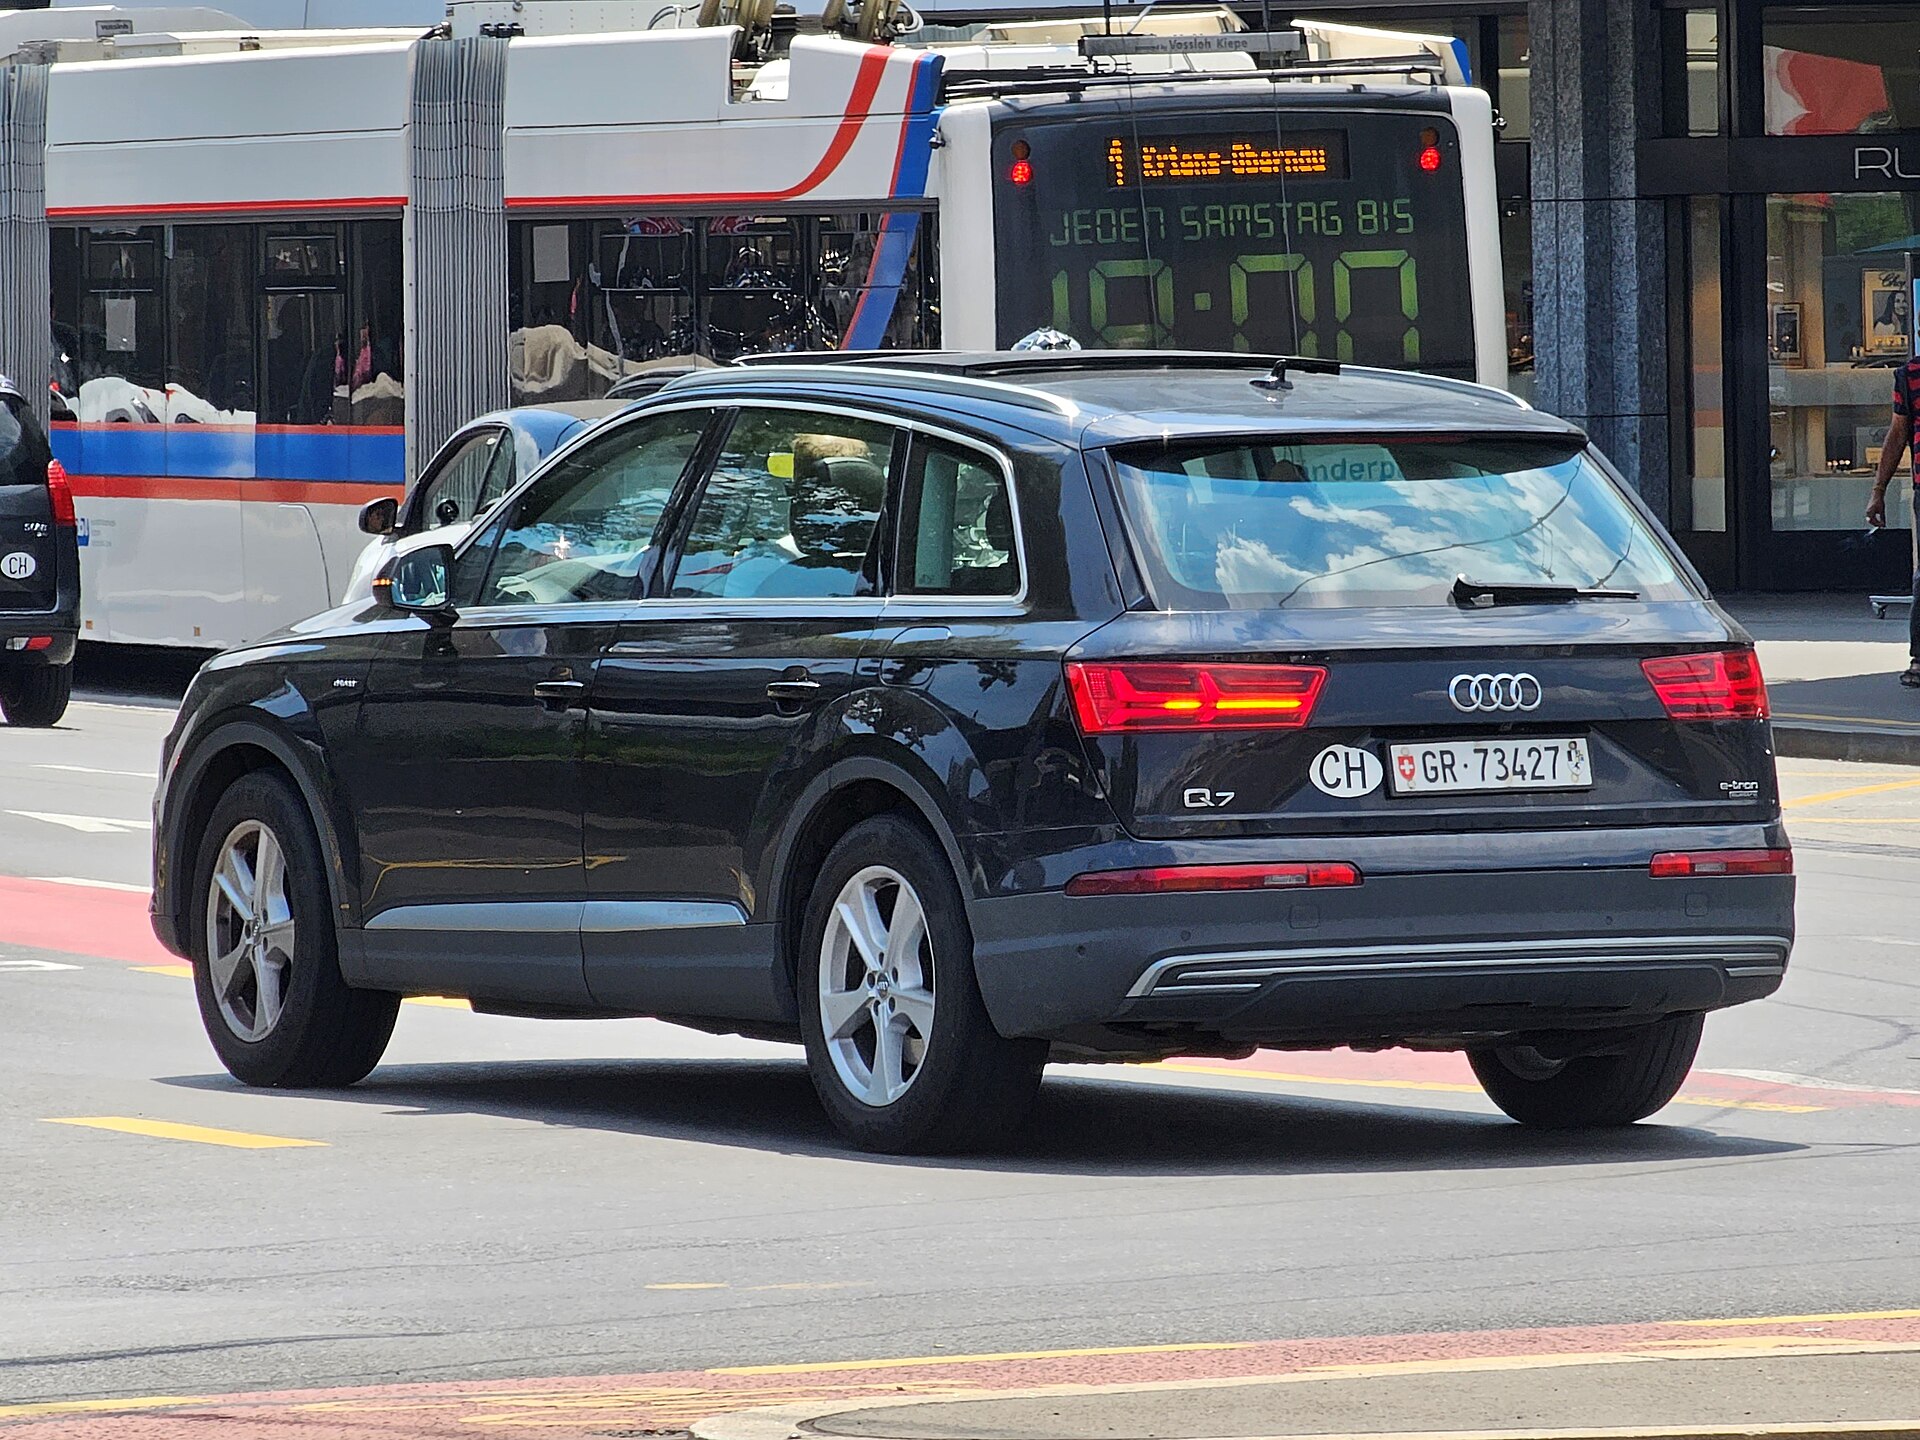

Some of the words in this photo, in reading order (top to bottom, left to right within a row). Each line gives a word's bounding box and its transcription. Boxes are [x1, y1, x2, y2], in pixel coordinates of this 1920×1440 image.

[1168, 37, 1212, 50] Vossloh
[1216, 37, 1248, 50] Kiepe
[1107, 139, 1124, 186] 1
[1180, 200, 1343, 241] SAMSTAG
[1357, 198, 1415, 236] BIS
[9, 556, 28, 575] CH
[1318, 749, 1368, 790] CH
[1719, 780, 1759, 790] e-tron
[1183, 788, 1235, 808] Q7
